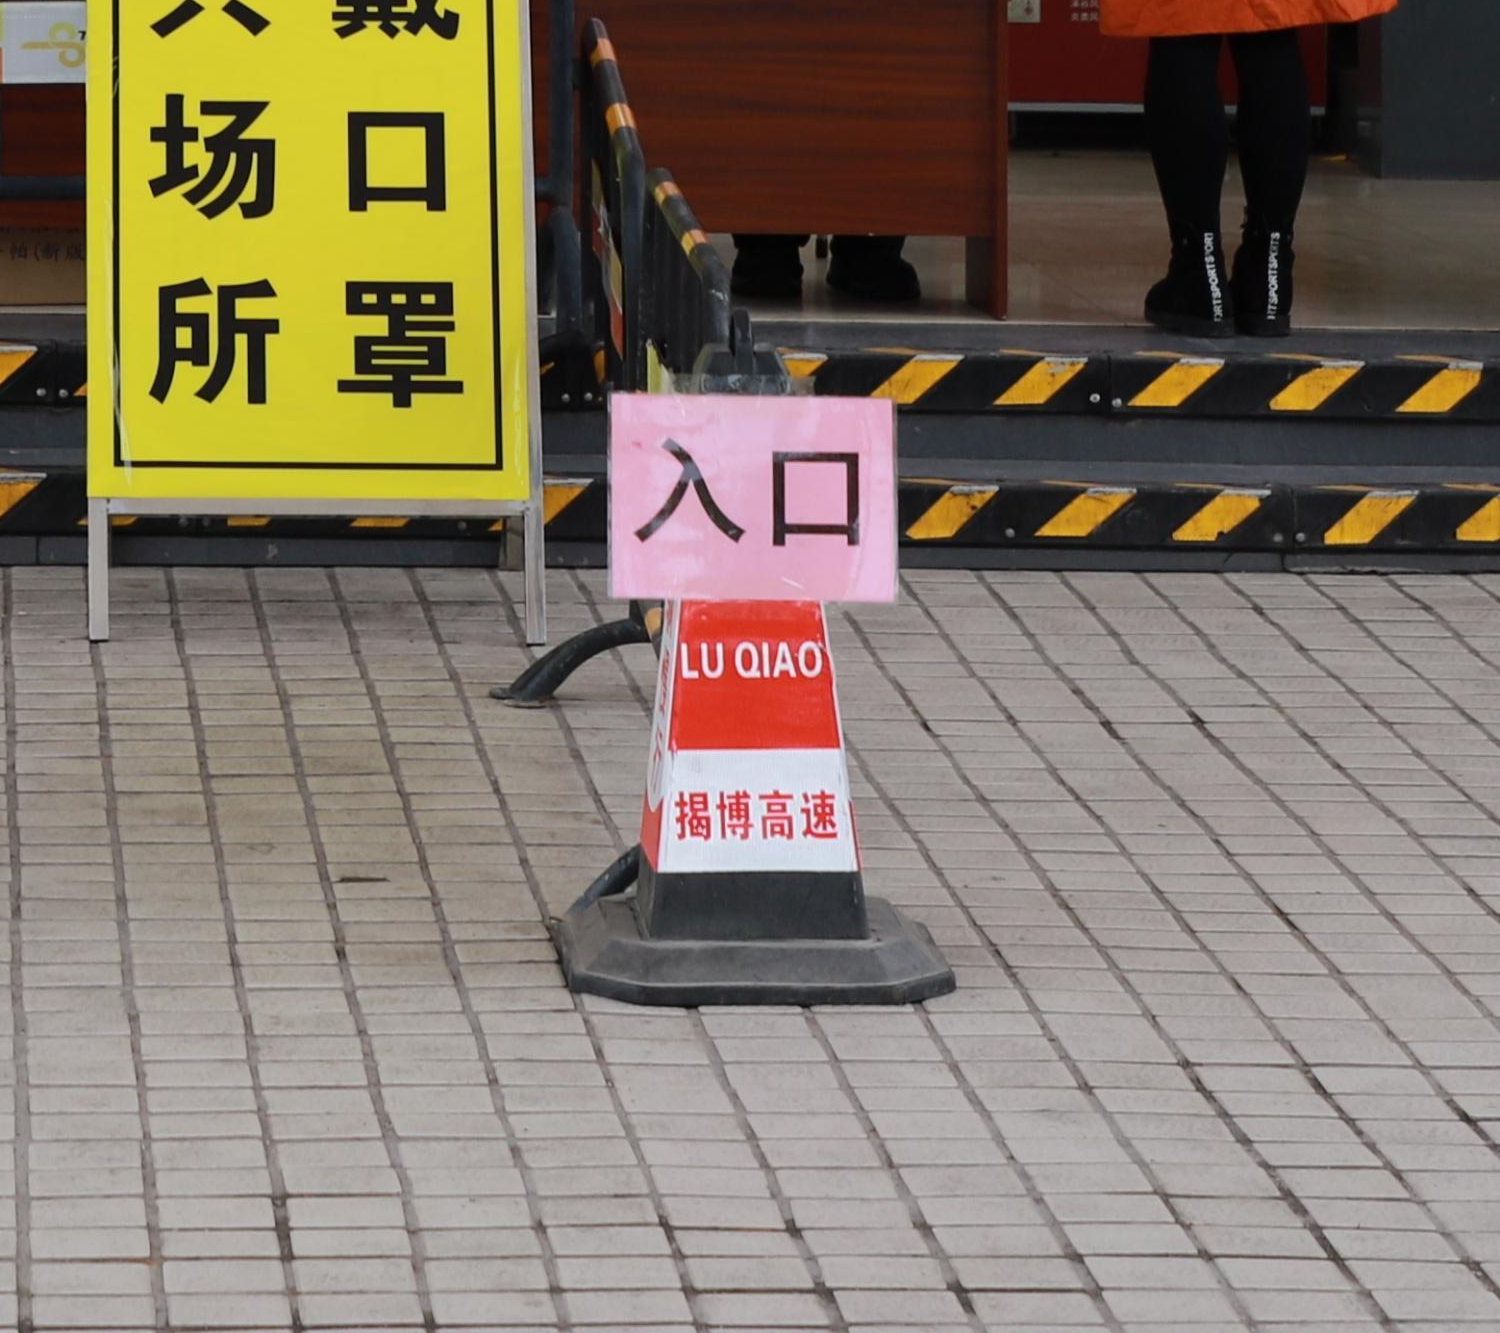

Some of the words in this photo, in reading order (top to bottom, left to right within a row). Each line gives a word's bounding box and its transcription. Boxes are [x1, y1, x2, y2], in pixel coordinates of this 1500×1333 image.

[635, 437, 859, 546] 入口
[680, 641, 724, 680] LU
[735, 640, 823, 679] QIAO
[675, 789, 839, 842] 揭博高速
